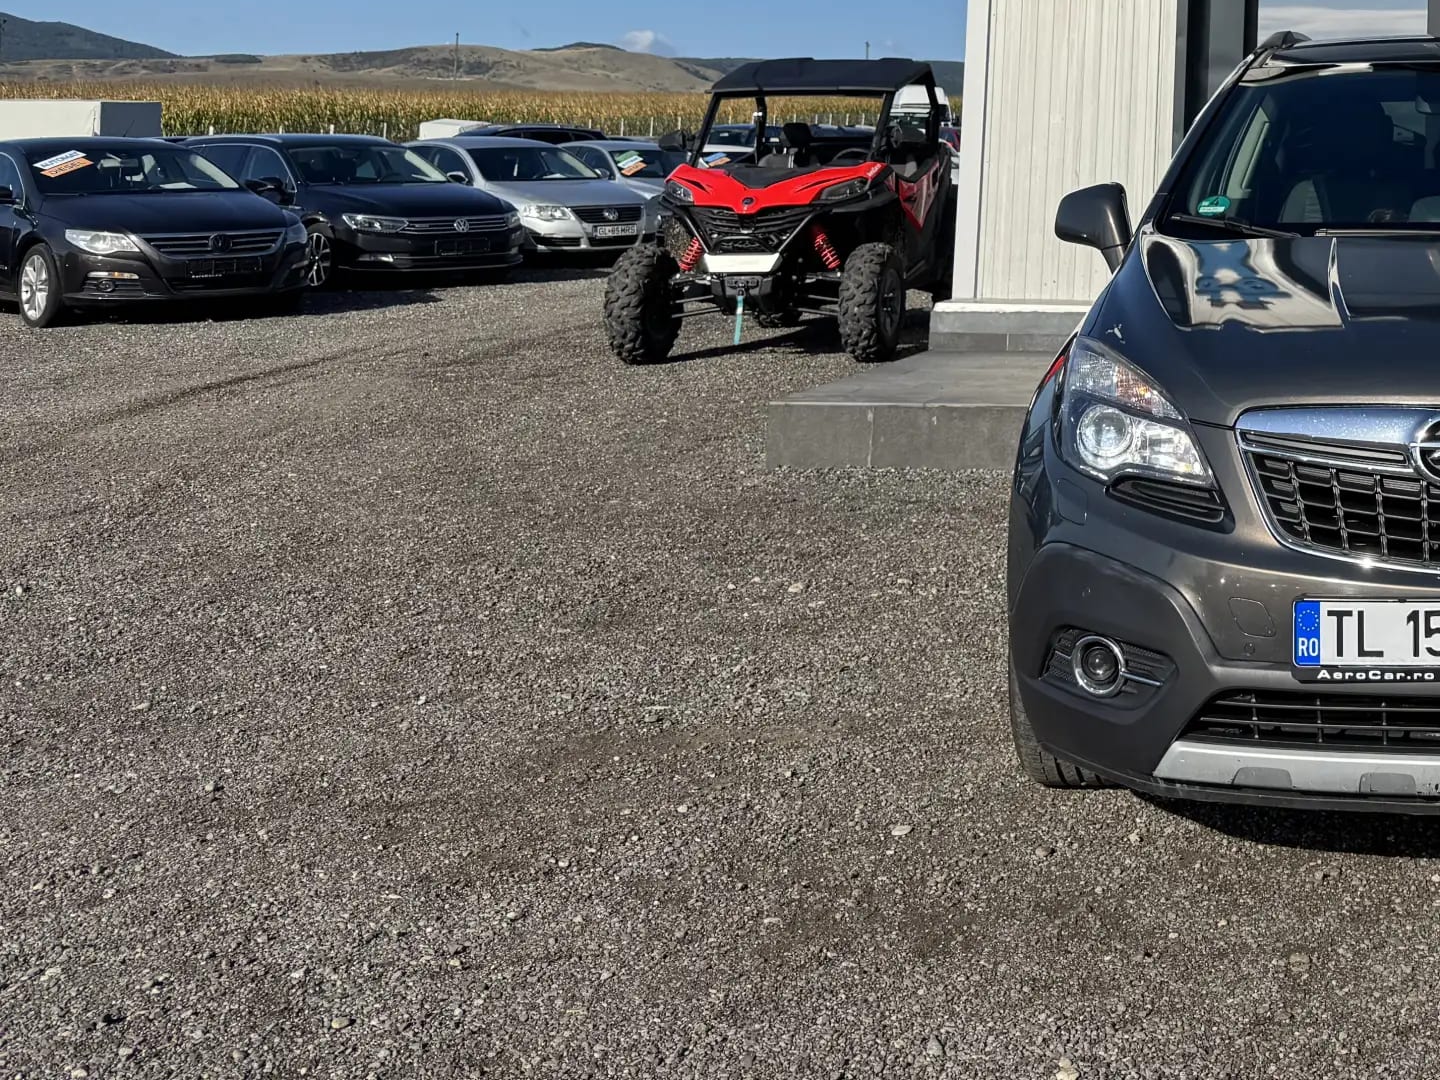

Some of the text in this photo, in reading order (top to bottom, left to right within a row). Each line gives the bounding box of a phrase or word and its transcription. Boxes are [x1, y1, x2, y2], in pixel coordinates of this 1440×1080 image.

[1327, 609, 1384, 658] TL
[1298, 637, 1319, 657] RO
[1316, 669, 1436, 681] AeroCar.ro
